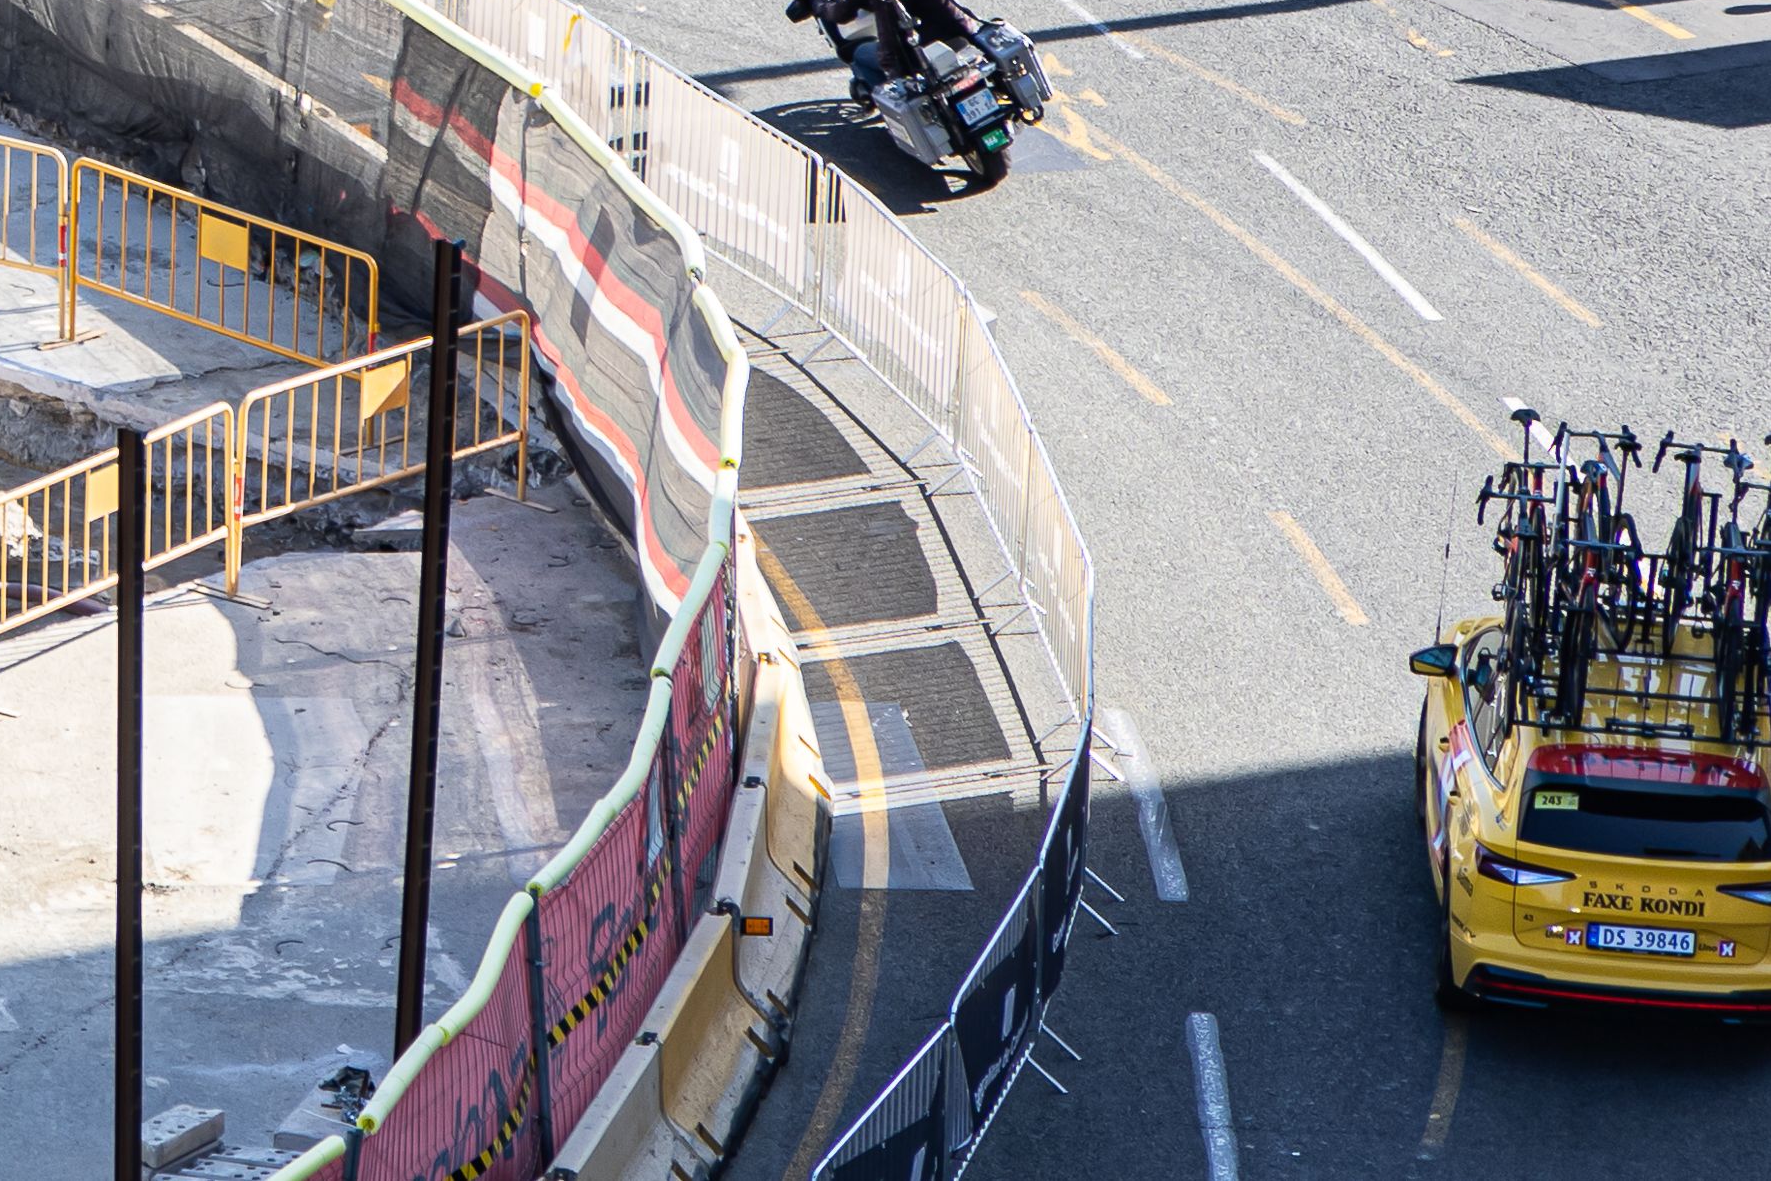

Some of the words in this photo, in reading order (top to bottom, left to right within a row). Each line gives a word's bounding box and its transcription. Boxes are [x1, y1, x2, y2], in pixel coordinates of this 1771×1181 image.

[1583, 892, 1633, 911] FAXE
[1640, 895, 1705, 917] KONDI
[1603, 928, 1626, 946] DS
[1634, 930, 1691, 951] 39846
